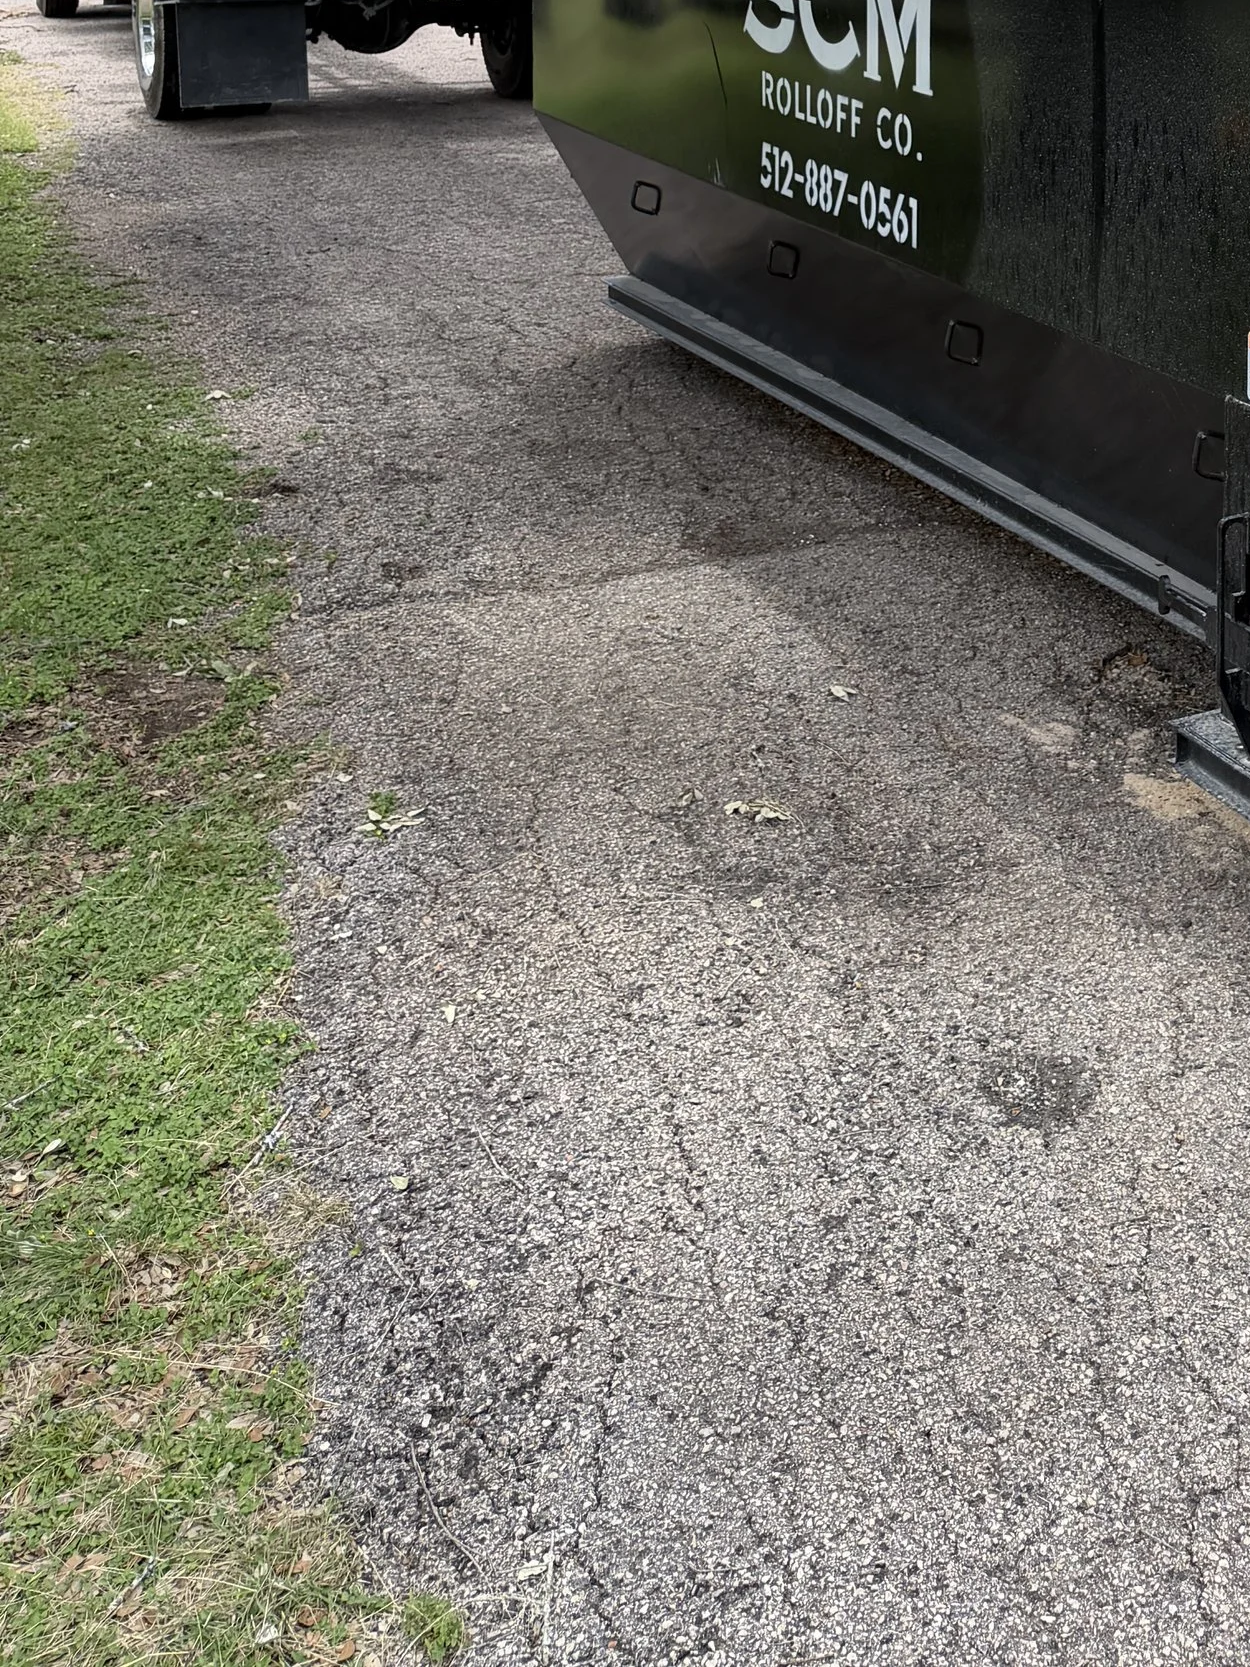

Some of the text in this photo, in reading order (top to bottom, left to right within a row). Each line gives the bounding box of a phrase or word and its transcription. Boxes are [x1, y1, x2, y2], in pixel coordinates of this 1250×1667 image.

[761, 70, 923, 162] ROLLOFF CO.
[760, 141, 918, 249] 512-887-0561
